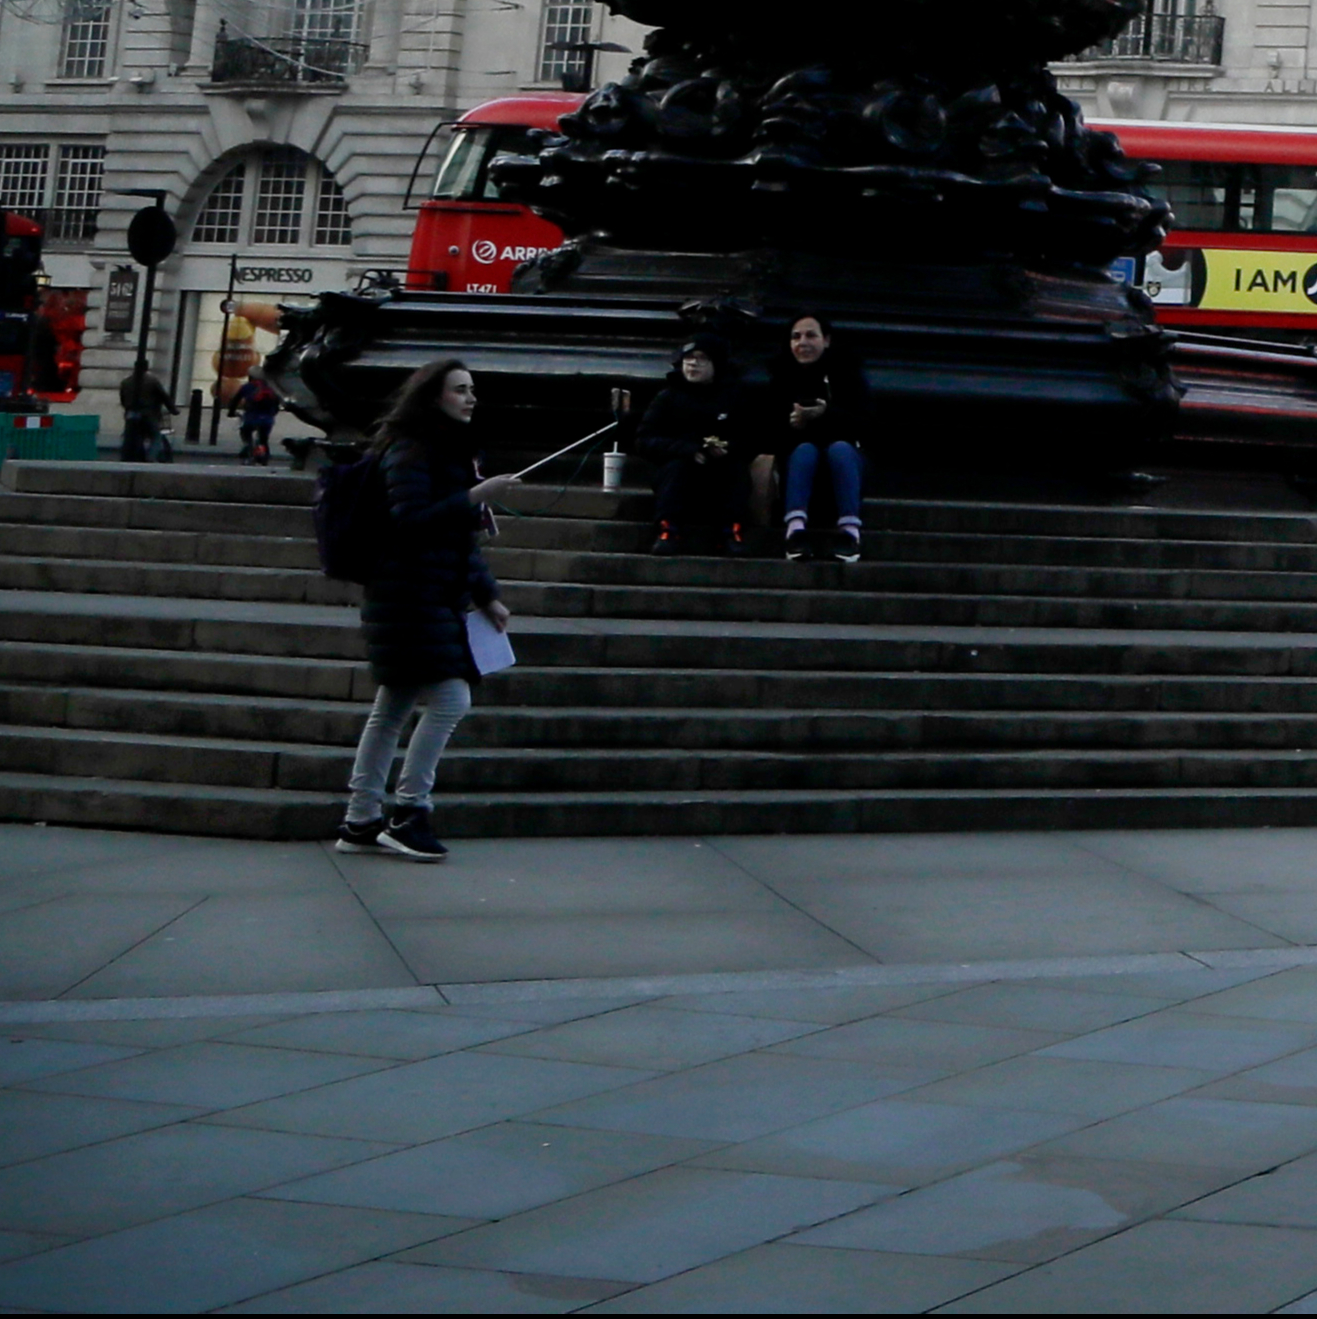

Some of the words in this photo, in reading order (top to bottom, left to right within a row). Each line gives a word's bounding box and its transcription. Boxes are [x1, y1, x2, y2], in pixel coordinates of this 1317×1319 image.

[500, 246, 561, 261] ARRI
[235, 267, 313, 284] NESPRESSO
[1234, 269, 1242, 291] I
[1246, 270, 1298, 294] AM
